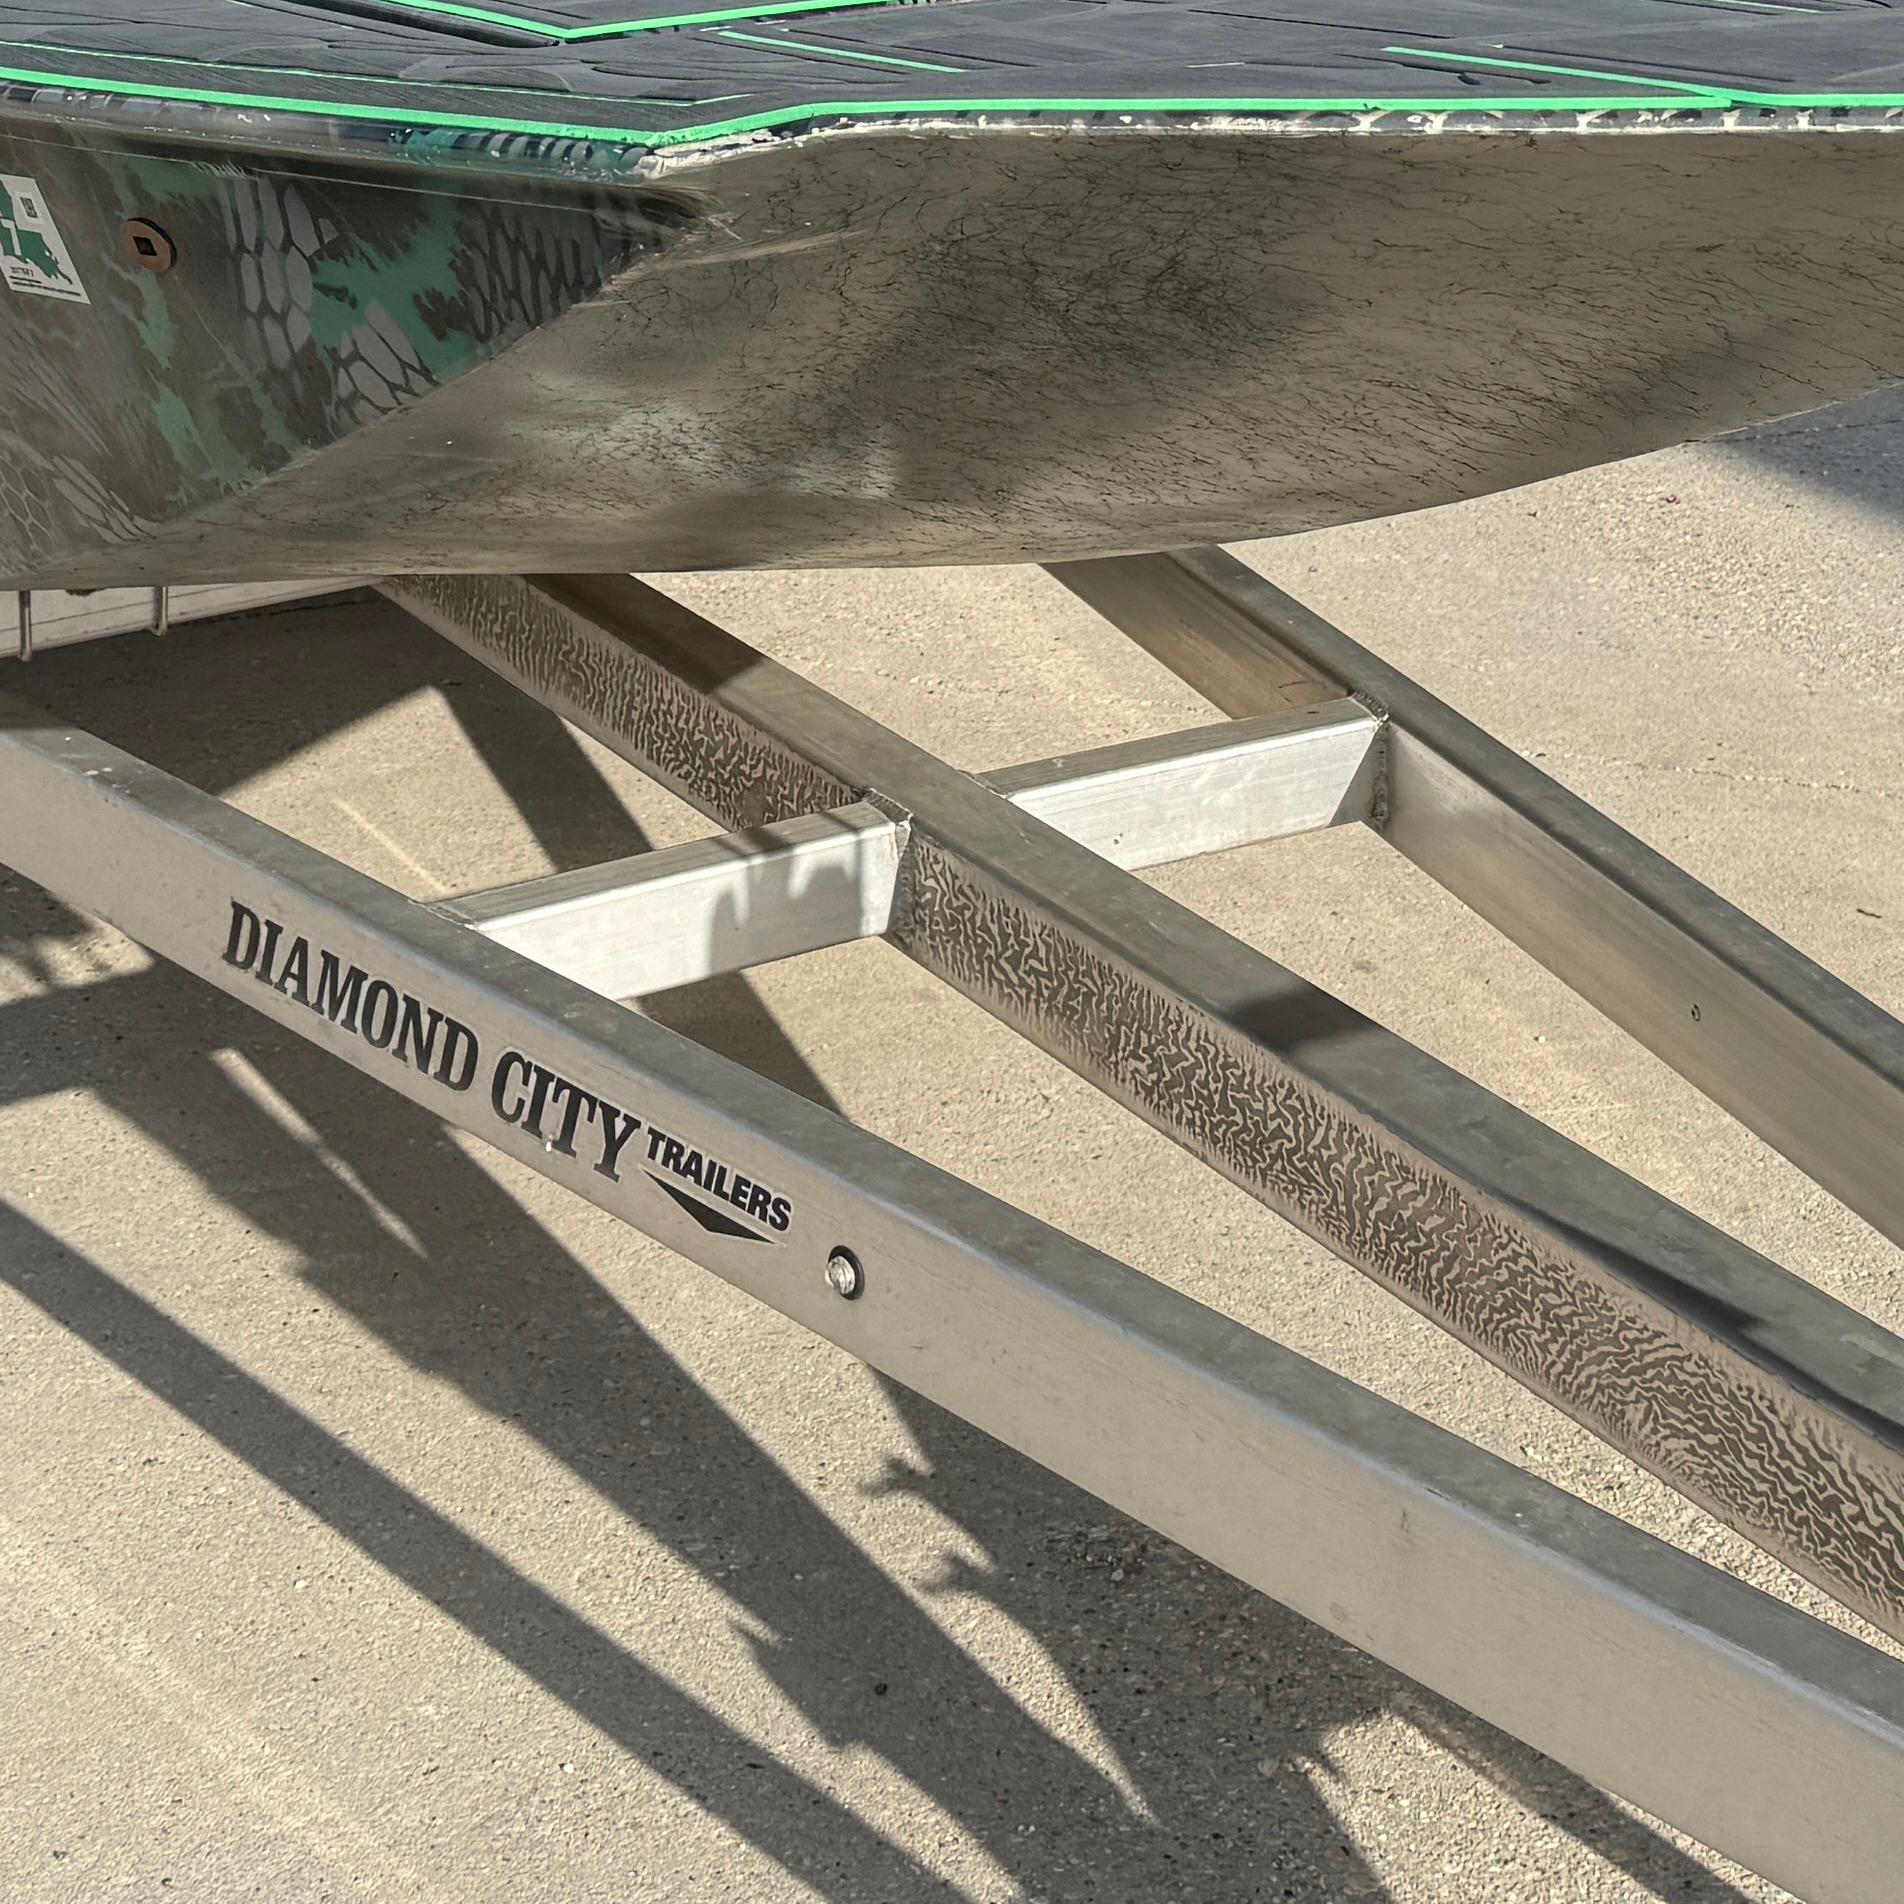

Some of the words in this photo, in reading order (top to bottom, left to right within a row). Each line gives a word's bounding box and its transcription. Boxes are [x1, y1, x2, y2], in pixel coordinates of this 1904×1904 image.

[0, 218, 22, 256] 7
[221, 899, 480, 1092] DIAMOND
[491, 1051, 643, 1184] CITY
[646, 1126, 793, 1233] TRAILERS
